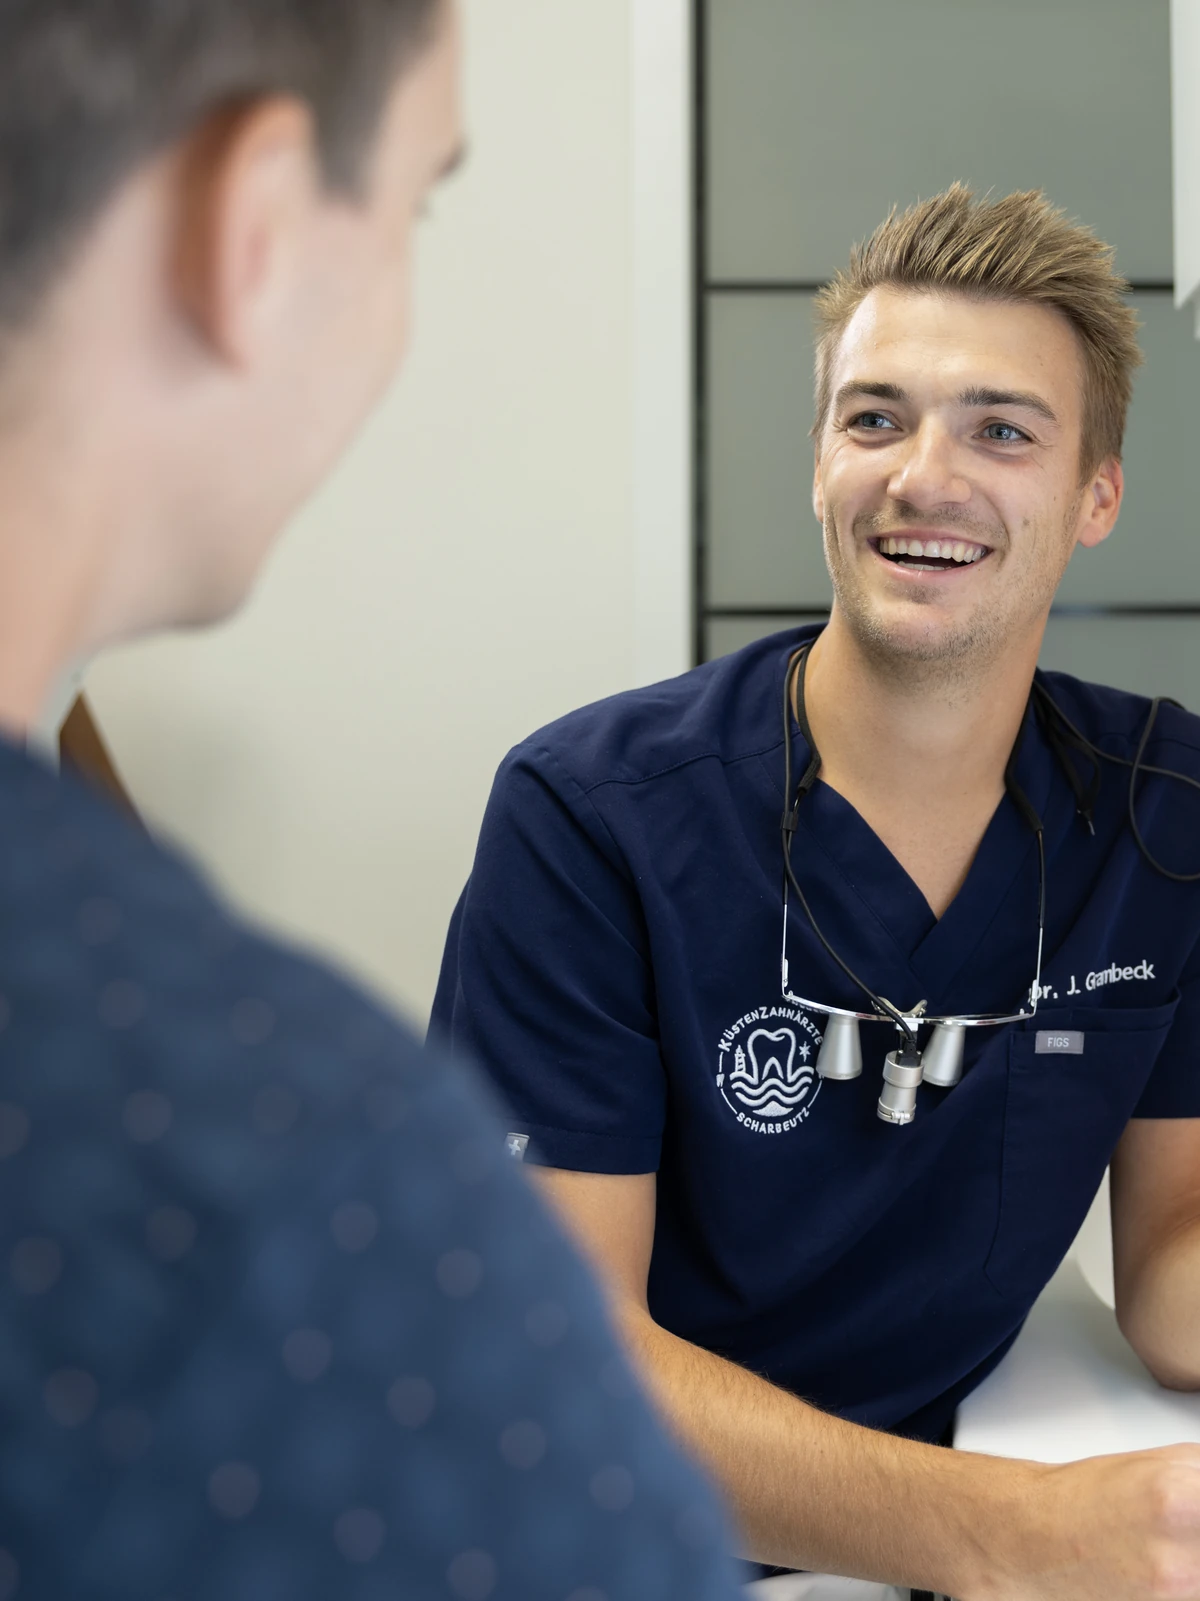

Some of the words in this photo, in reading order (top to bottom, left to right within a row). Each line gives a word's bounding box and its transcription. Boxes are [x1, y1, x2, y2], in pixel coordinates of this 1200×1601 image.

[1066, 975, 1082, 996] J.
[718, 1006, 824, 1053] KÜSTENZAHNÄRZTE
[1047, 1037, 1070, 1048] FIGS
[736, 1106, 810, 1135] SCHARBEUTZ
